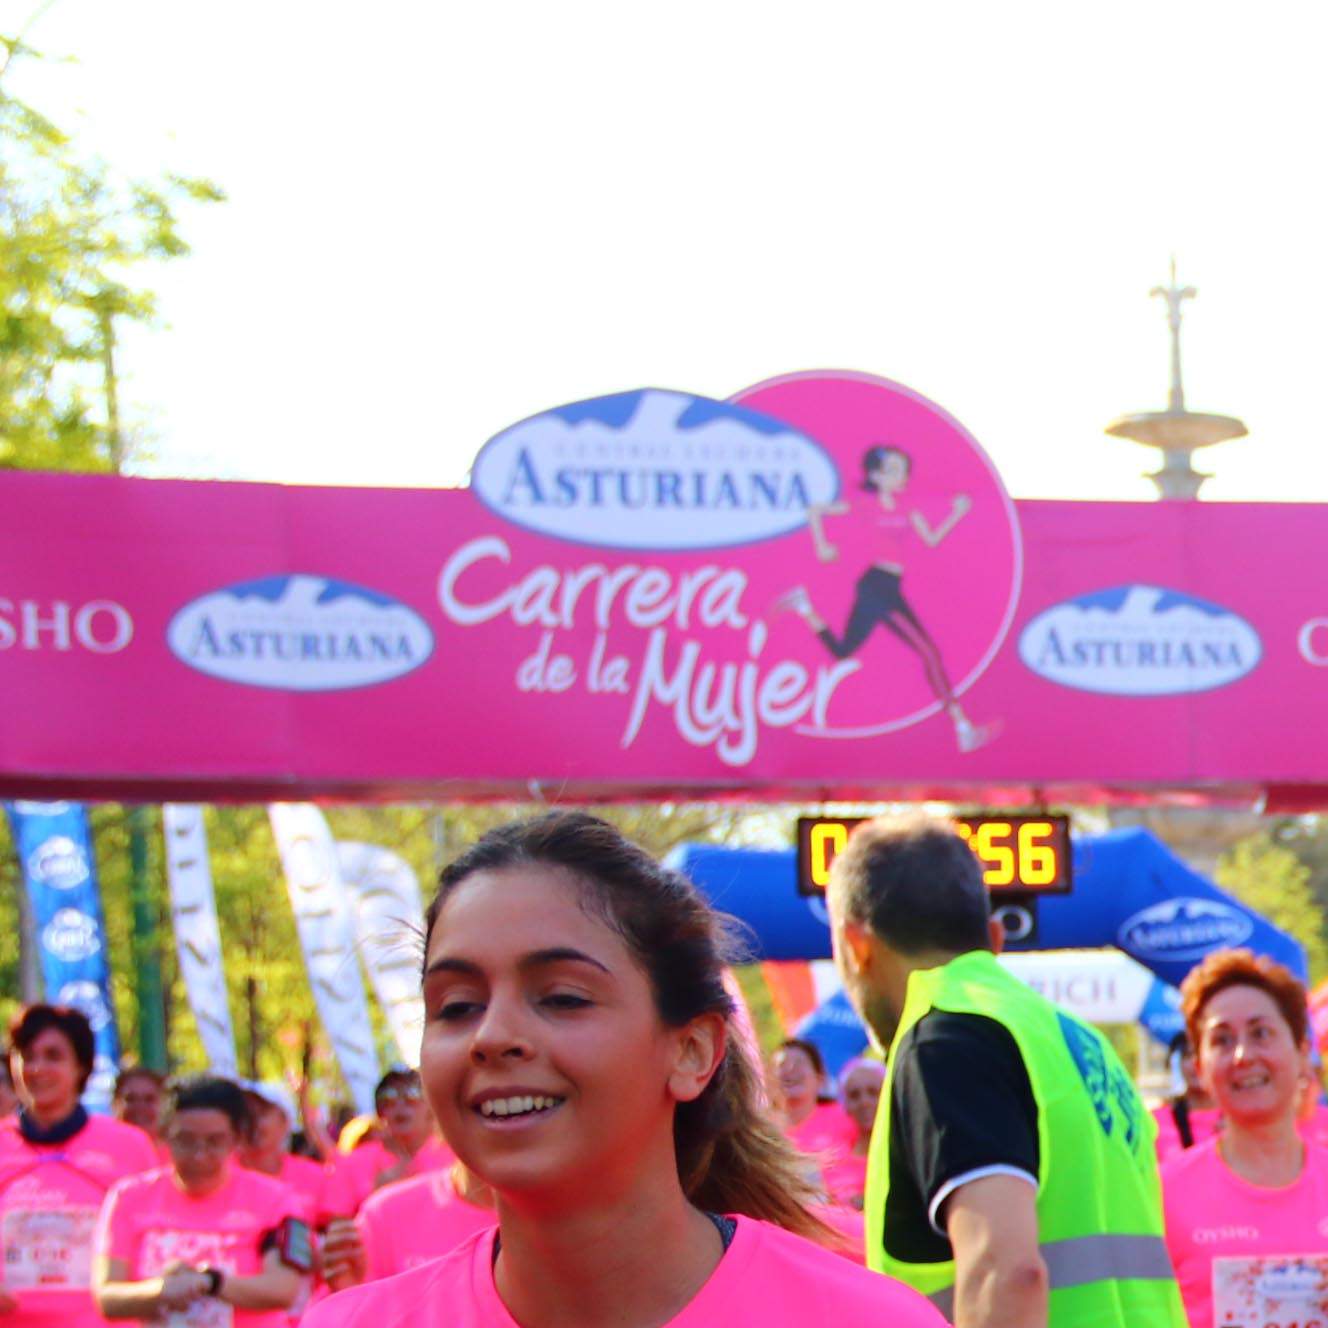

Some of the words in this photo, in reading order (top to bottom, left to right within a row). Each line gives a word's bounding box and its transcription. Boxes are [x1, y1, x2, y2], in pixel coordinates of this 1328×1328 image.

[503, 447, 810, 510] ASTURIANA
[437, 536, 749, 629] Carrera
[191, 616, 415, 661] ASTURIANA
[1037, 627, 1243, 668] ASTURIANA
[517, 632, 579, 692] de
[587, 630, 630, 693] la
[622, 622, 862, 766] Mujer
